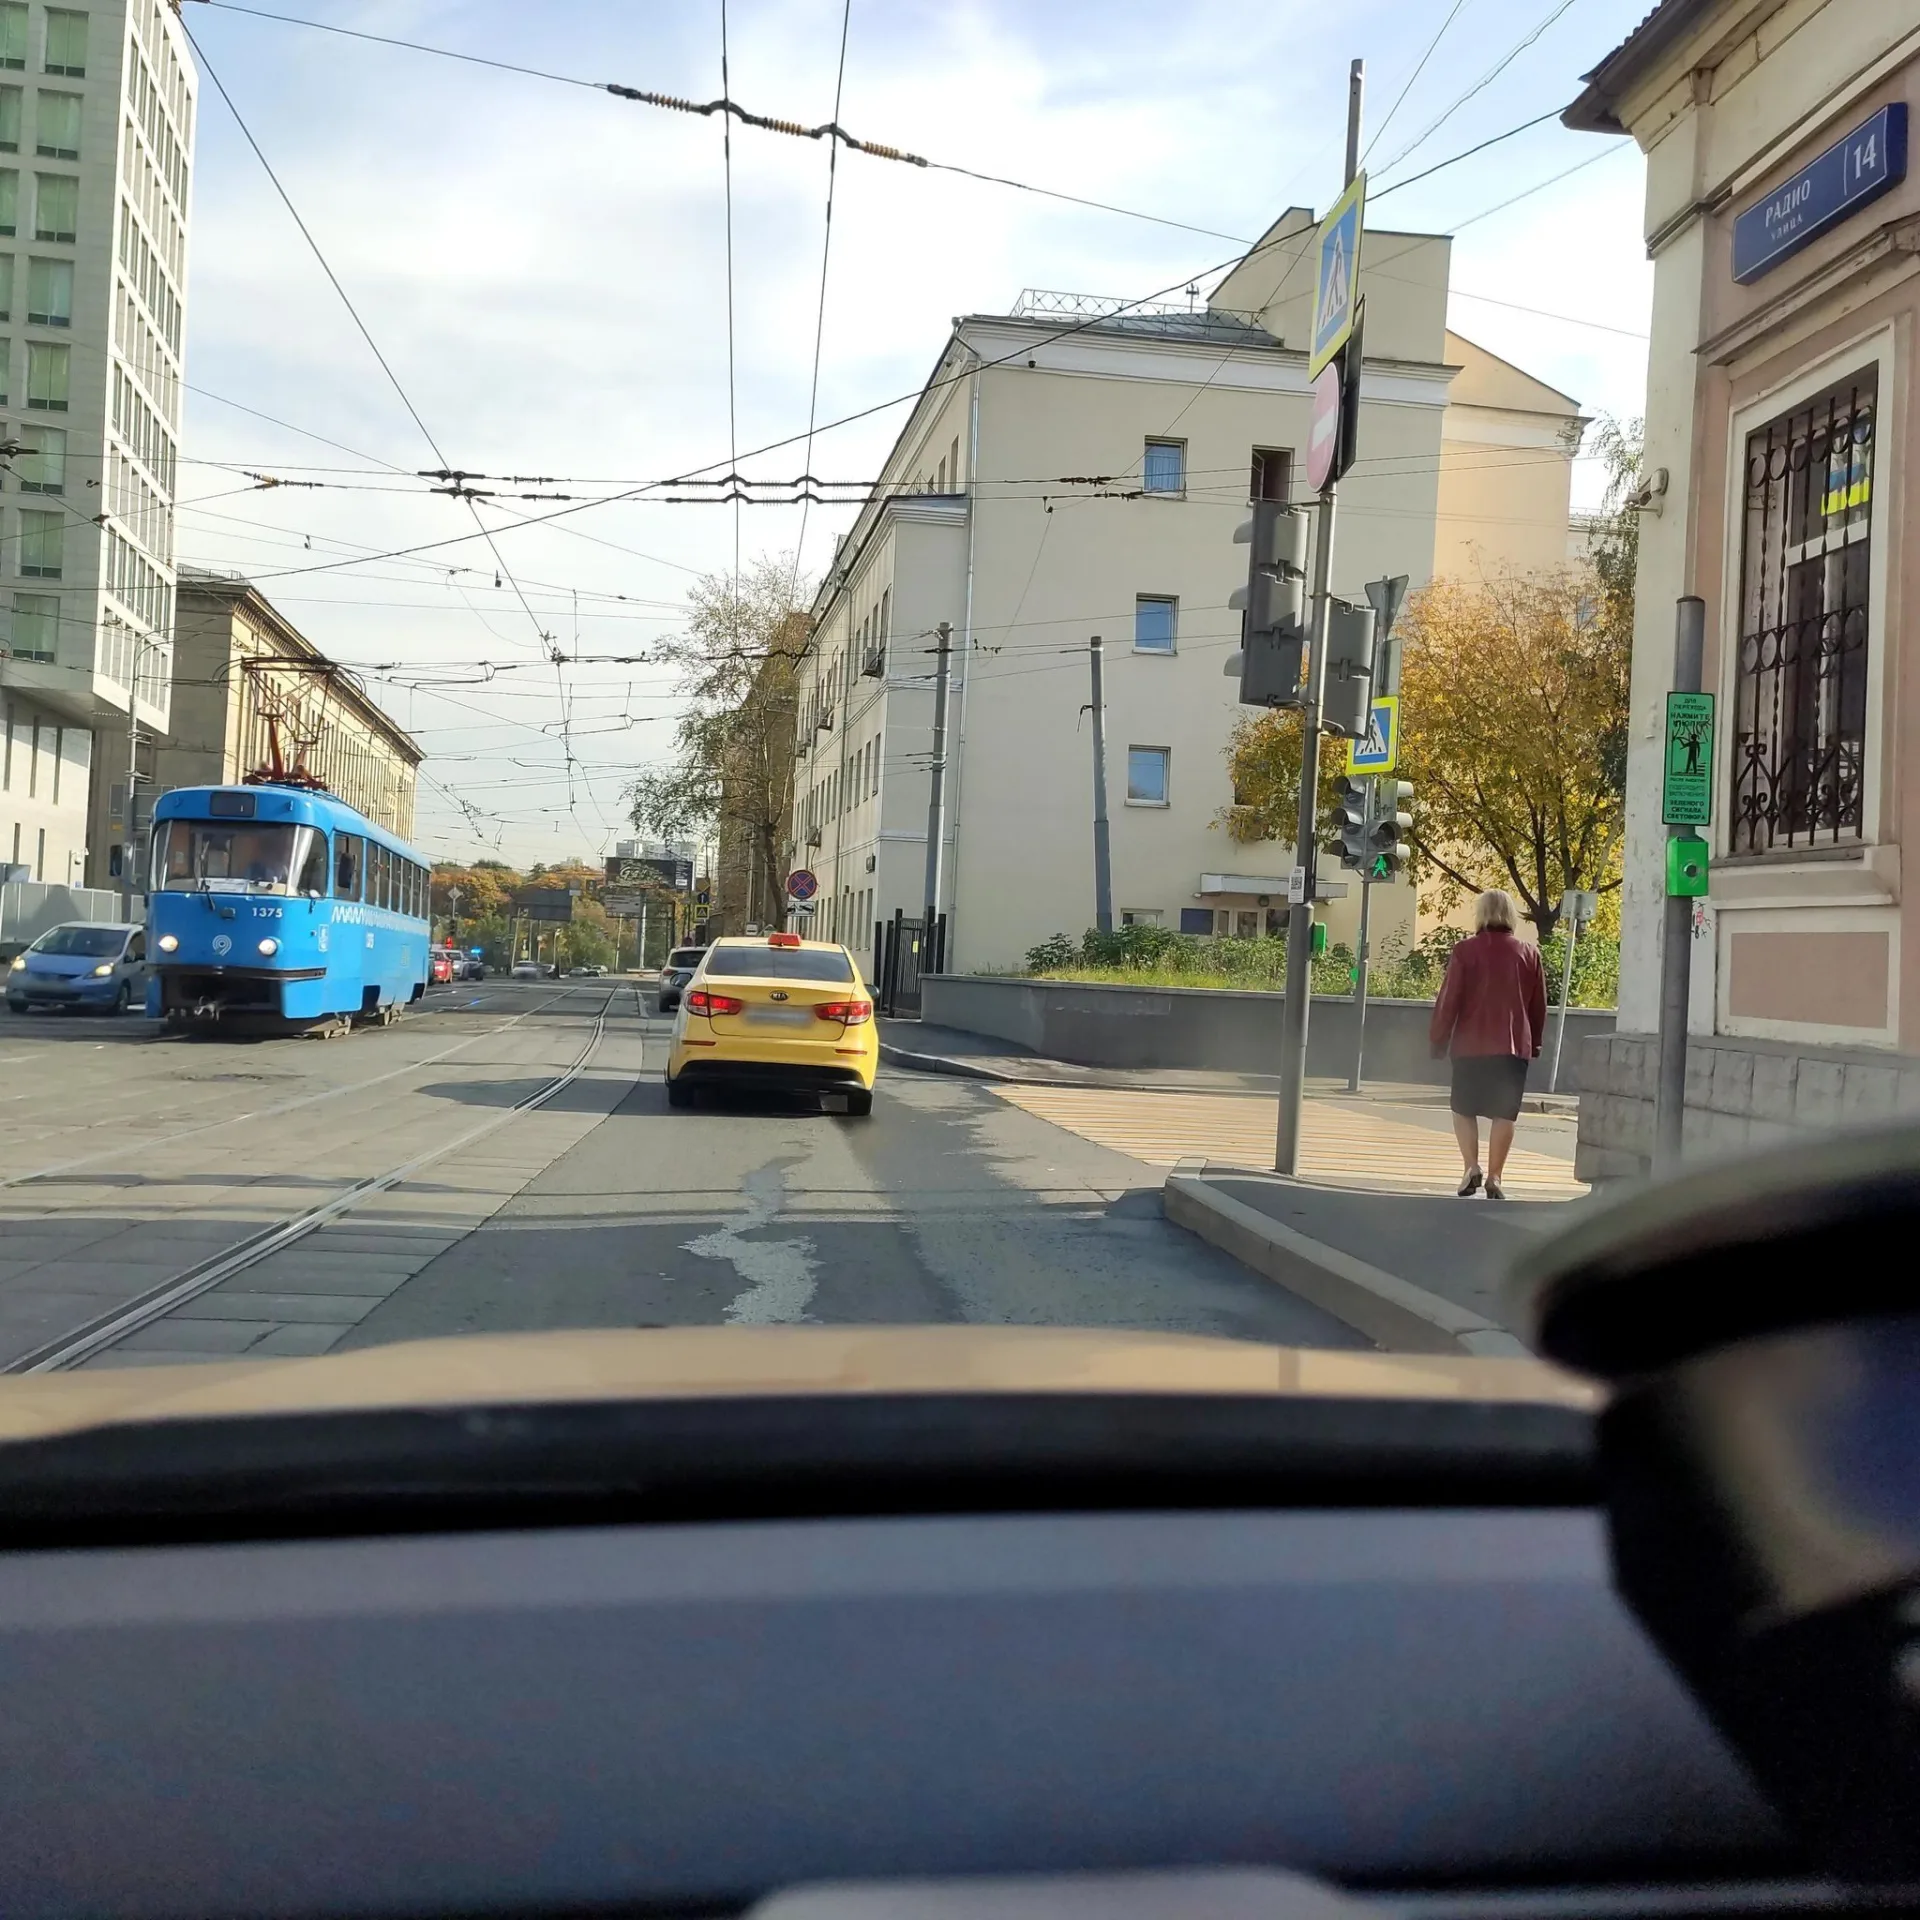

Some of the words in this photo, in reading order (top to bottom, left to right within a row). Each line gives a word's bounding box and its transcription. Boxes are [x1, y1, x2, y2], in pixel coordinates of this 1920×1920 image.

[1853, 134, 1876, 179] 14
[1765, 179, 1811, 228] РАДИО
[1670, 712, 1711, 720] НАЖМИТЕ
[252, 907, 283, 918] 1375
